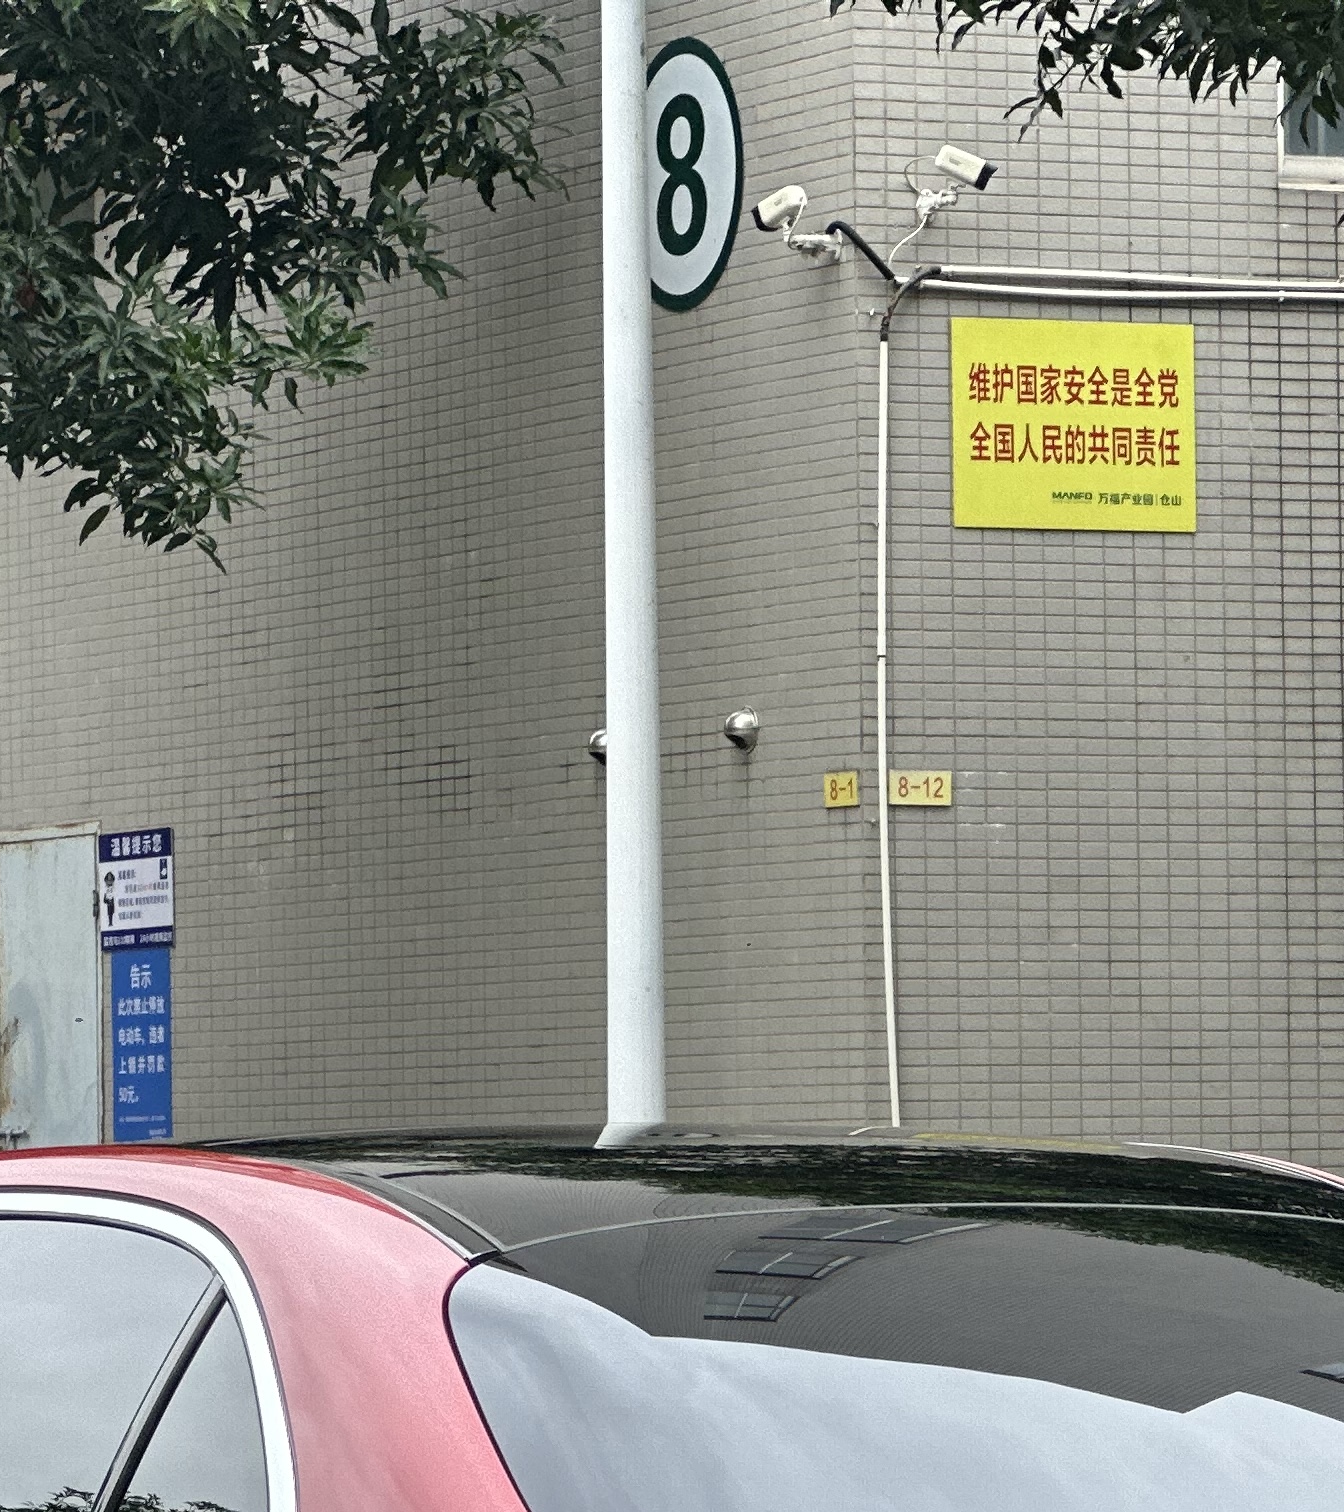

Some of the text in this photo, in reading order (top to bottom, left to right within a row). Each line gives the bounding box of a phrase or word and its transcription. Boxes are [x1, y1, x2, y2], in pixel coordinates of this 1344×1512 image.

[656, 92, 708, 257] 8
[968, 362, 1181, 408] 维护国家安全是全党
[969, 421, 1181, 468] 全国人民的共同责任
[1097, 492, 1154, 506] 万福产业园
[1159, 493, 1182, 506] 仓山
[829, 778, 854, 800] 8-1
[897, 775, 944, 798] 8-12
[129, 963, 152, 990] 告示
